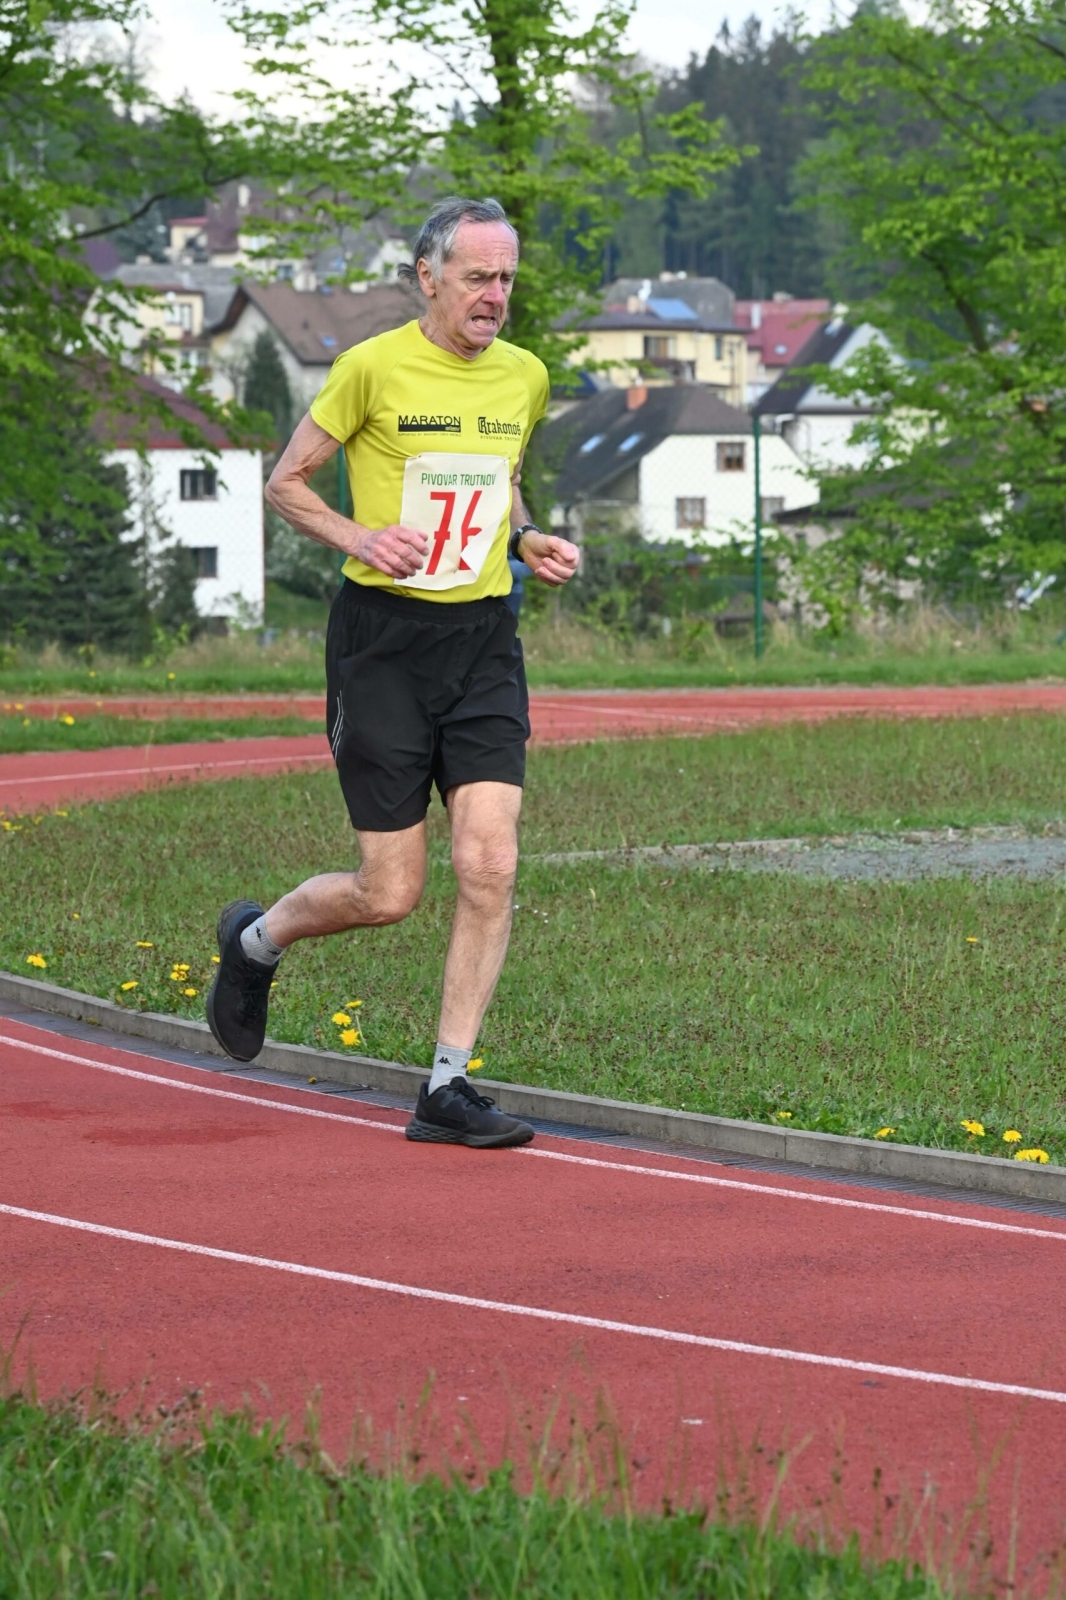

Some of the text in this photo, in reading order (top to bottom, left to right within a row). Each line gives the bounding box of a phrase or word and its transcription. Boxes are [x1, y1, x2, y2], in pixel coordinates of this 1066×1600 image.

[398, 415, 461, 425] MARATON
[478, 416, 521, 435] Krakonoš
[421, 472, 496, 486] PIVOVAR TRUTNOV
